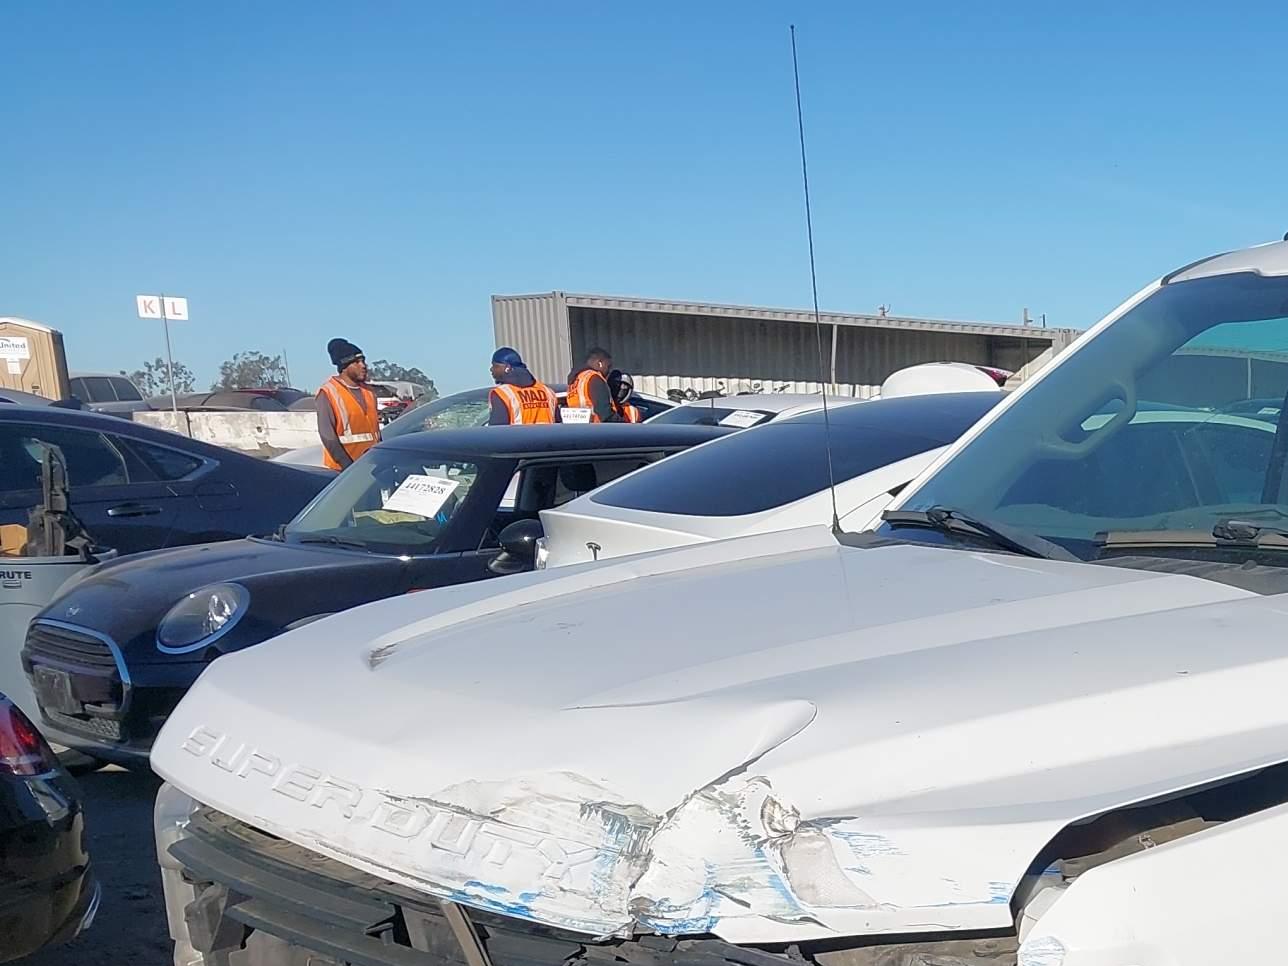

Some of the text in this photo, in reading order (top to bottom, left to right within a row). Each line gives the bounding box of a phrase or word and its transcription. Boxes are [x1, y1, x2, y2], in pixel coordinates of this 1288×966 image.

[143, 299, 155, 313] K
[172, 301, 182, 315] L
[517, 389, 547, 403] MAD
[0, 571, 32, 580] RUTE
[181, 725, 601, 880] SUPER DUTY
